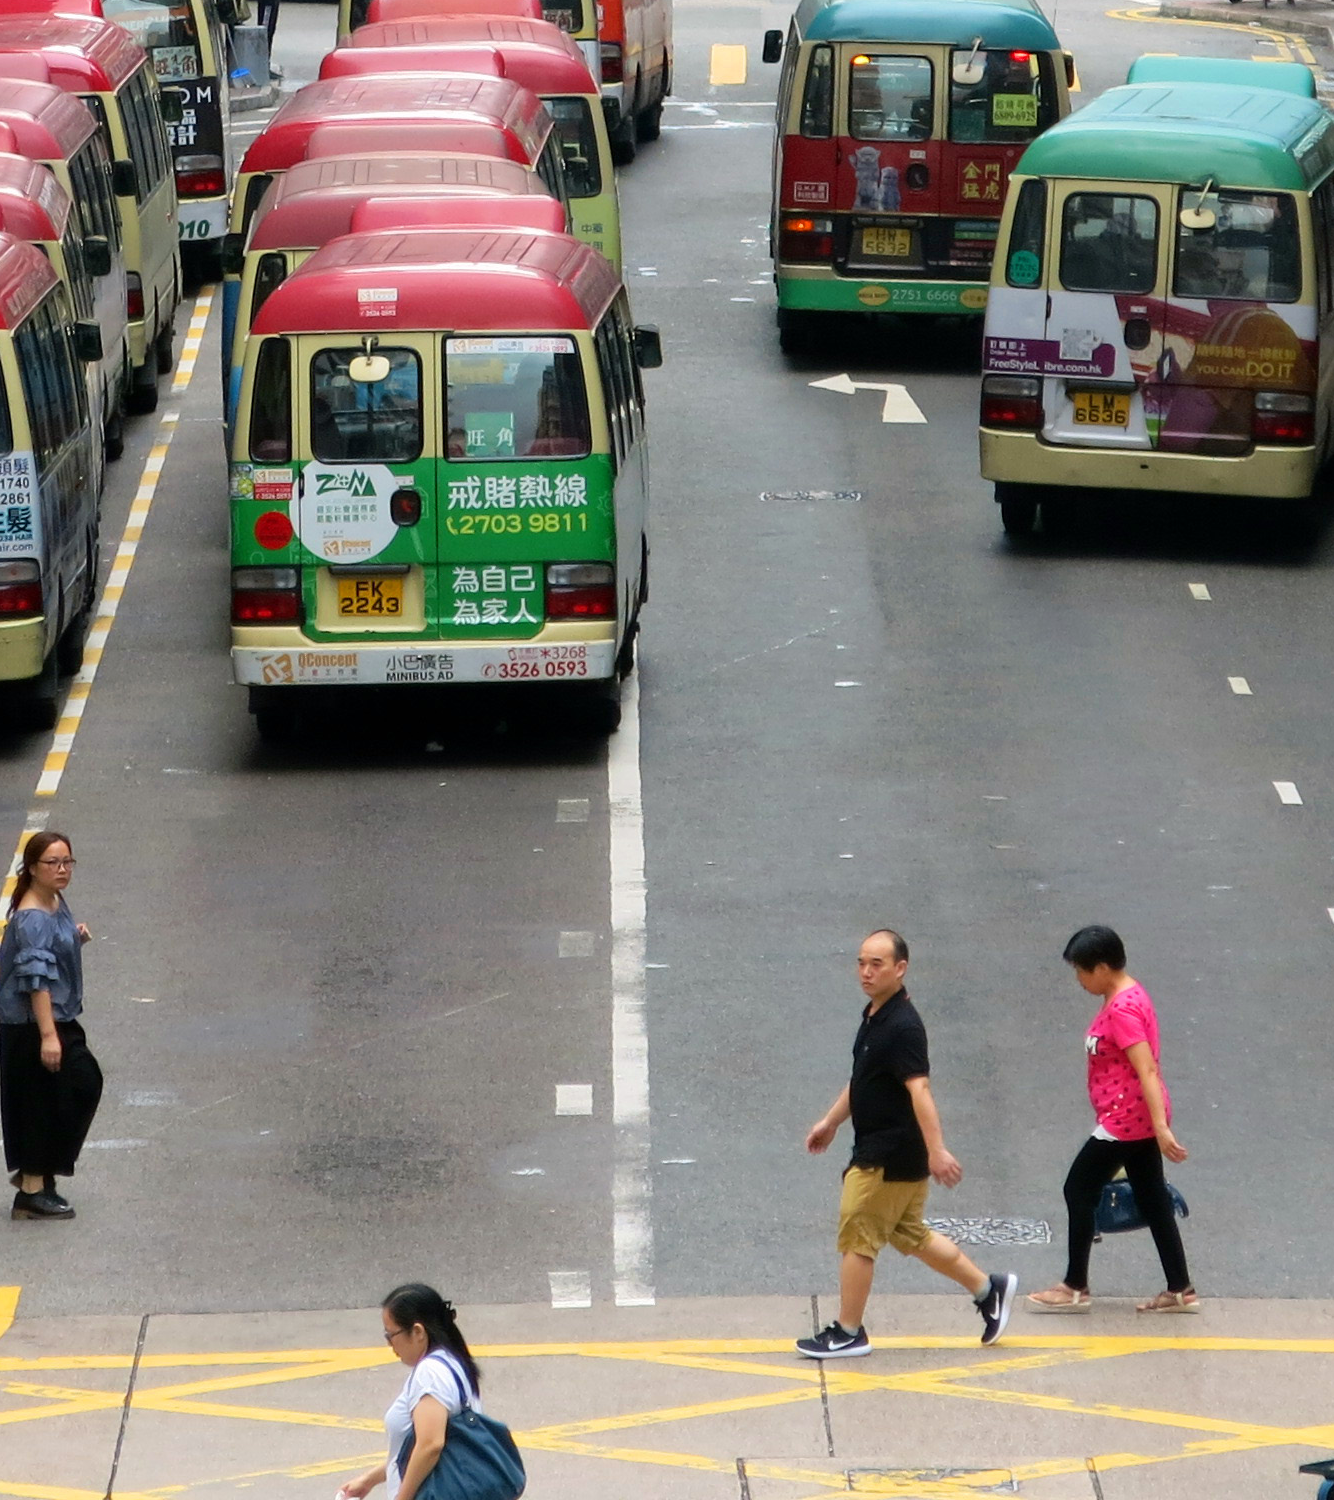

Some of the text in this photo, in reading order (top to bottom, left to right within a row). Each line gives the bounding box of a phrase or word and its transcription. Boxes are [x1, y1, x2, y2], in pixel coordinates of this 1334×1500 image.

[892, 289, 921, 300] 2751
[926, 290, 958, 301] 6666
[1197, 361, 1294, 378] YOU CAN DO IT
[1087, 393, 1116, 408] LM
[1075, 408, 1126, 424] 6636
[467, 428, 514, 448] 旺角
[0, 478, 30, 490] 1740
[447, 474, 588, 510] 戒賭熱線
[0, 493, 31, 505] 2861
[458, 512, 588, 534] 2703 9811
[15, 534, 34, 542] HAIR
[355, 580, 384, 597] FK
[452, 566, 536, 594] 為自己
[340, 596, 401, 614] 2243
[453, 599, 537, 626] 為家人
[298, 653, 359, 668] QConcept
[386, 653, 454, 671] 小巴廣告
[386, 670, 454, 682] MINIBUS AD
[498, 661, 588, 679] 3526 0593
